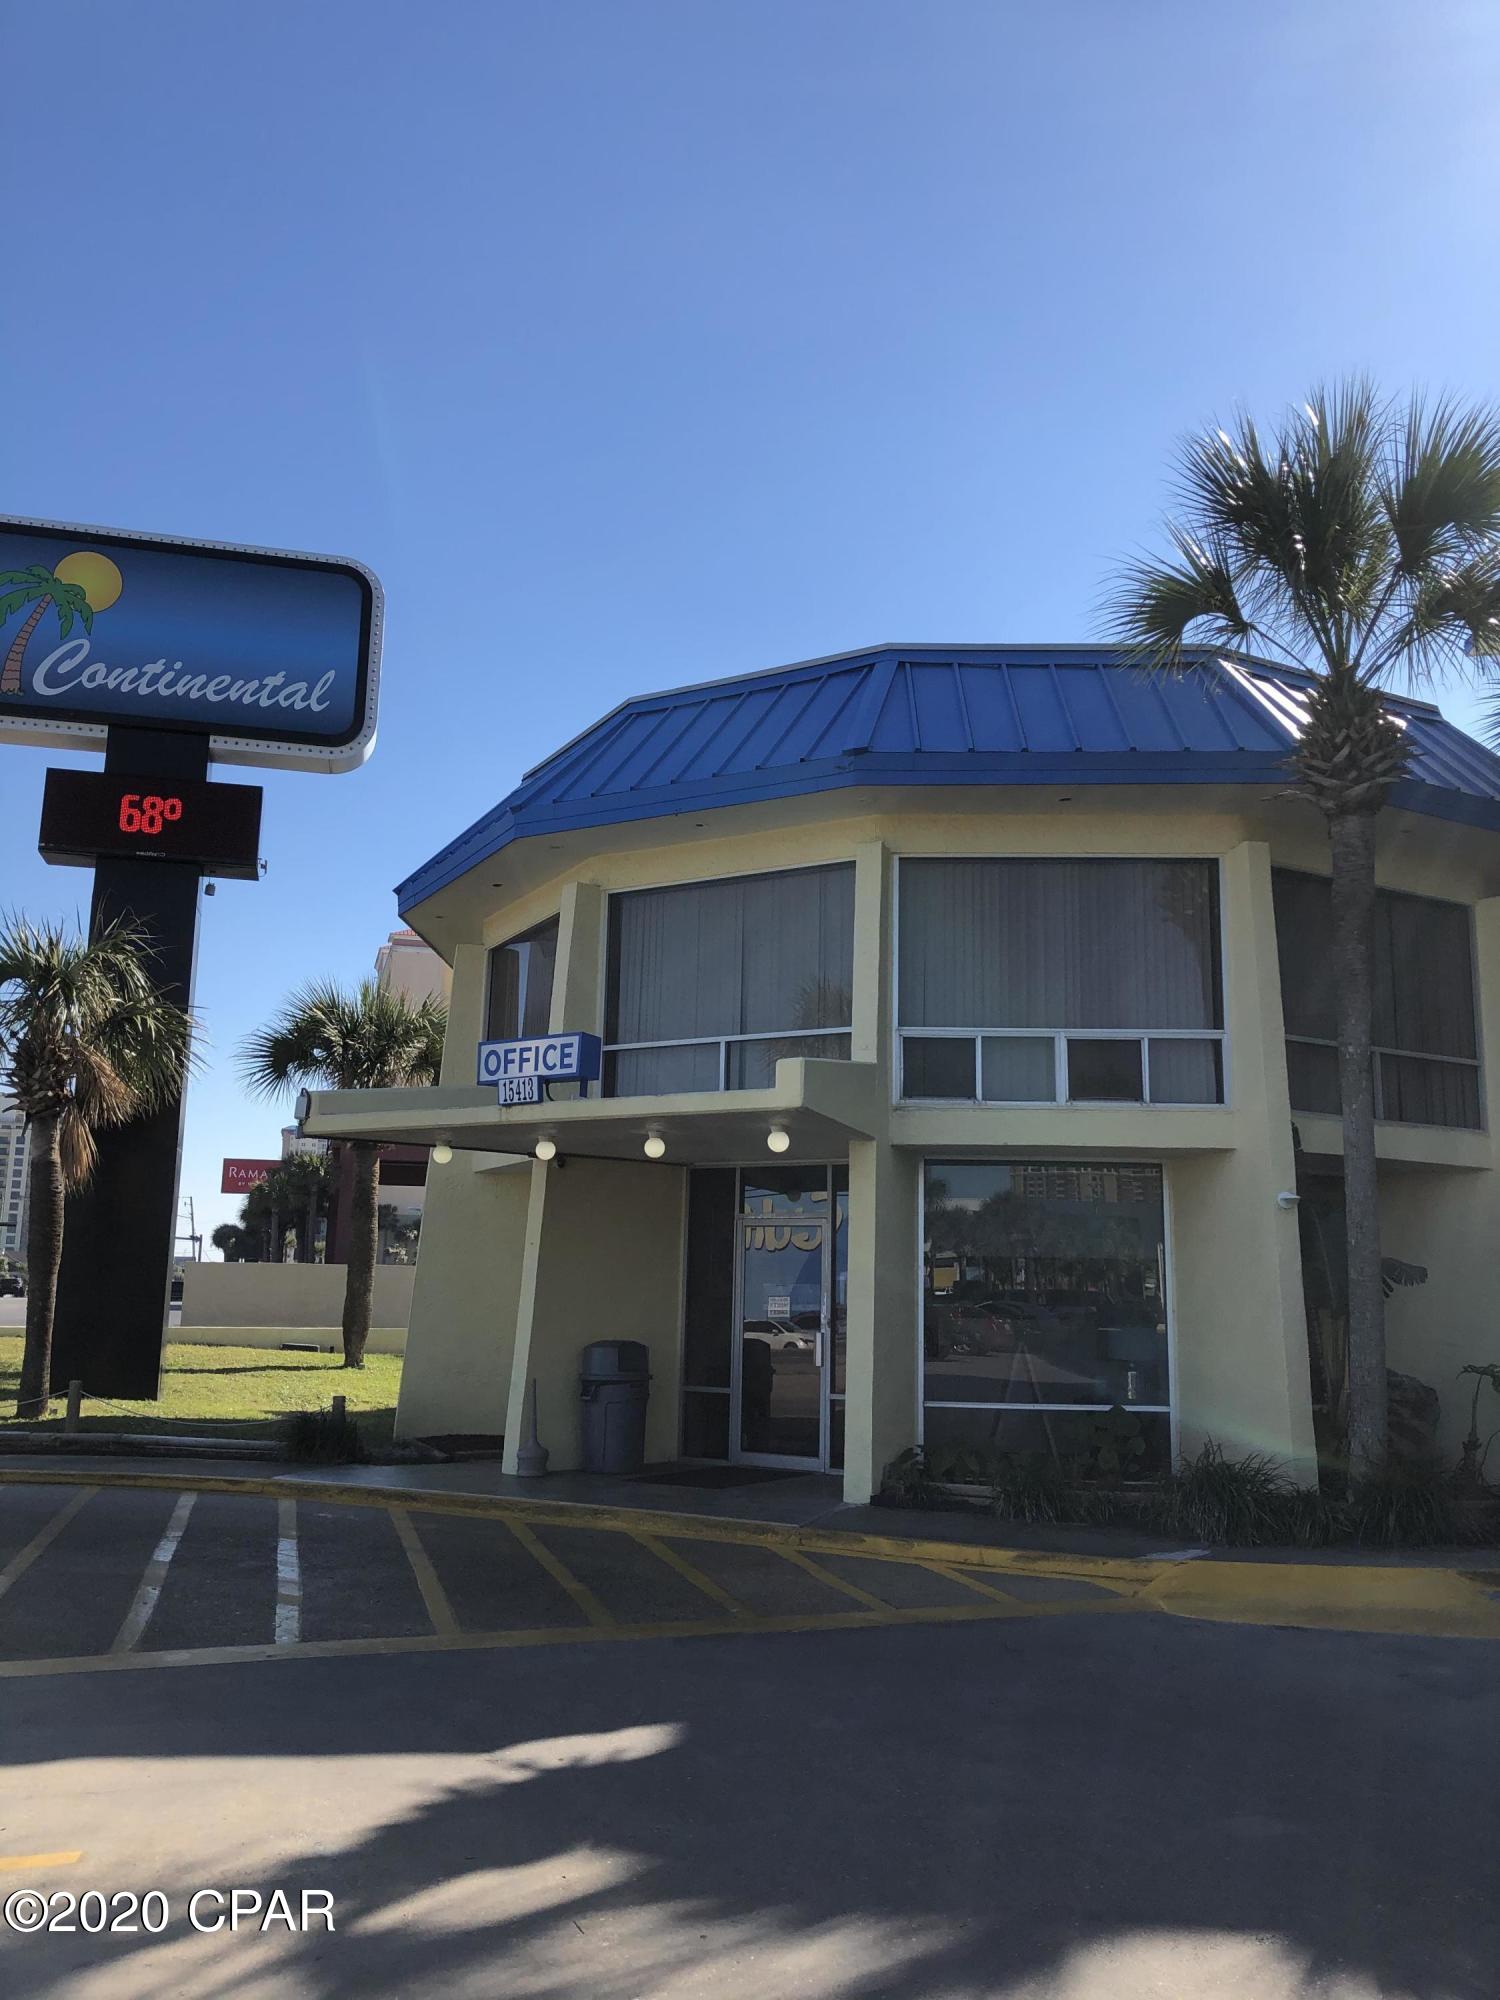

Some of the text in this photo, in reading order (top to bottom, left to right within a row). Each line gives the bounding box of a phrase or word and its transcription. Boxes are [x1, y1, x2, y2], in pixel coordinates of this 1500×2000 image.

[32, 638, 336, 712] Continental
[484, 1042, 574, 1077] OFFICE
[502, 1077, 534, 1103] 15413
[229, 1166, 269, 1179] RAMA
